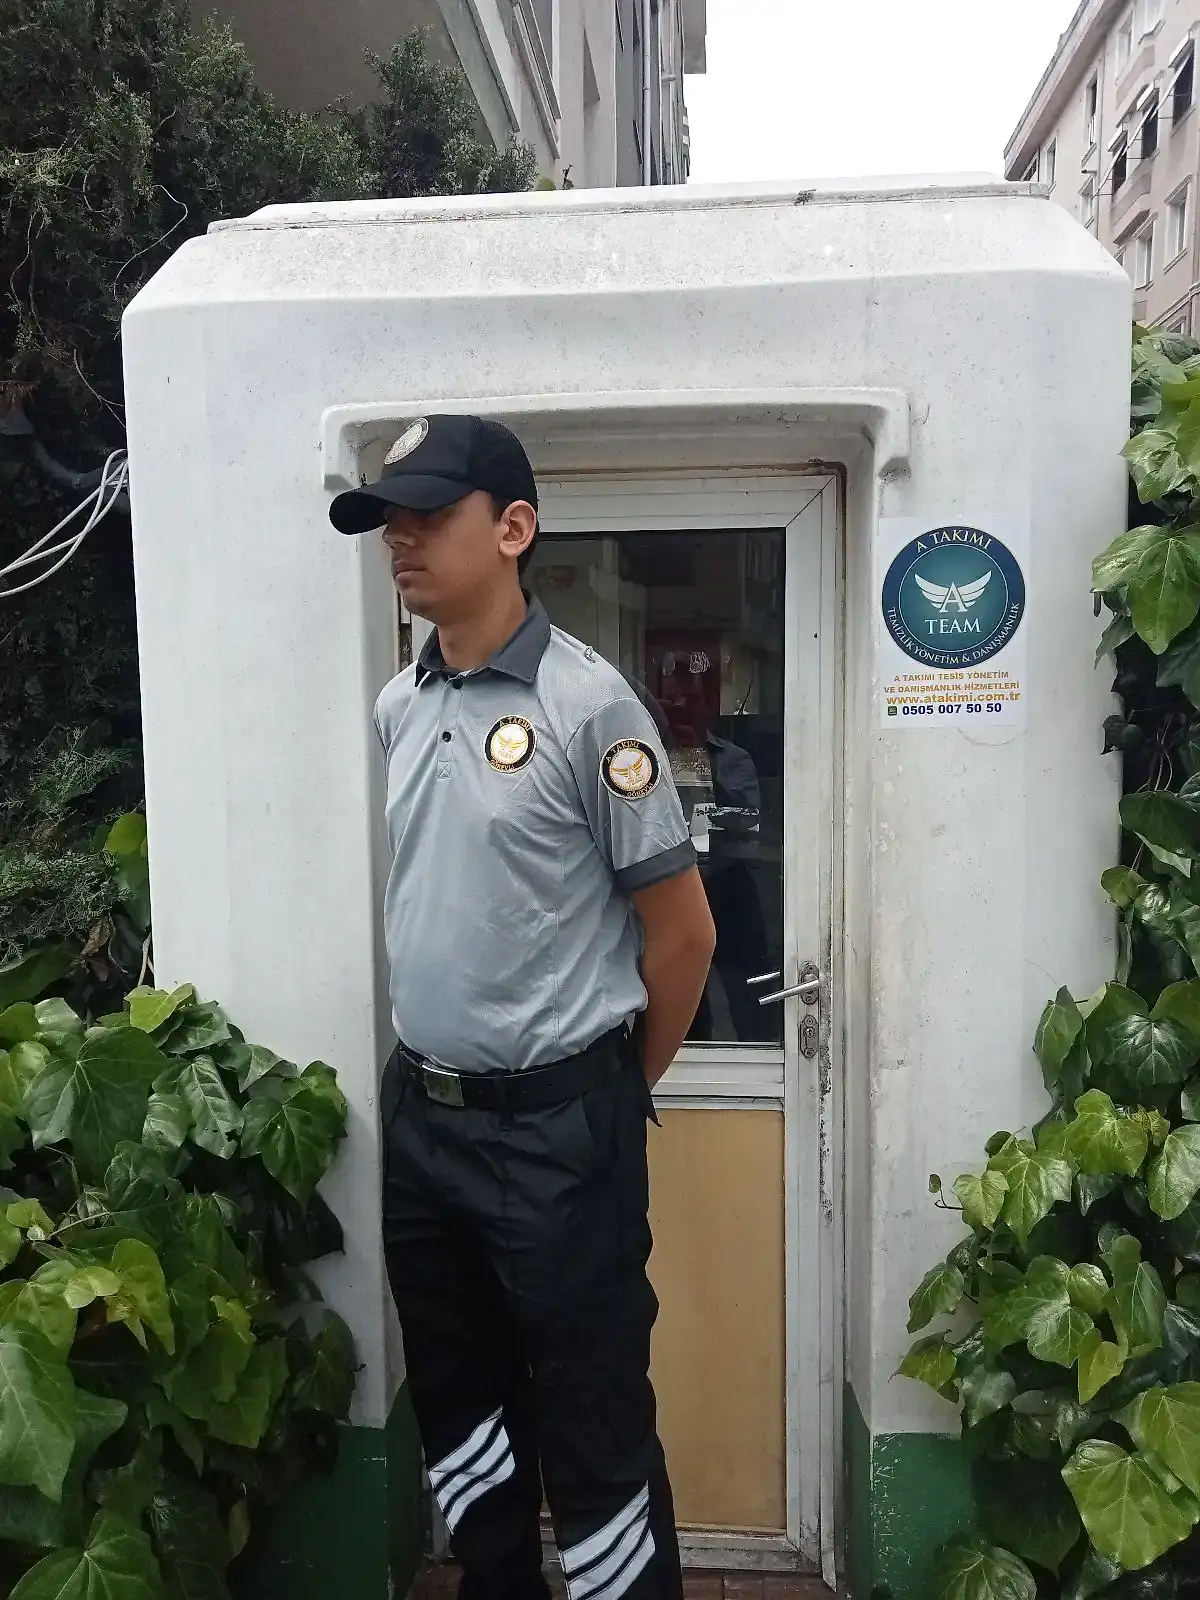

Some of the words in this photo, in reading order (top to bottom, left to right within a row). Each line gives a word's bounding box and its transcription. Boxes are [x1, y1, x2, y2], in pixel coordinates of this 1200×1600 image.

[916, 539, 928, 554] A
[929, 529, 992, 550] TAKIMI
[924, 617, 982, 635] TEAM
[961, 653, 973, 663] &
[902, 673, 935, 682] TAKIMI
[883, 686, 896, 694] VE
[898, 684, 962, 694] DANIŞMANLIK
[886, 691, 1021, 705] www.atakimi.com.tr
[902, 705, 934, 716] 0505
[938, 704, 962, 714] 007
[966, 703, 982, 714] 50
[986, 702, 1002, 713] 50
